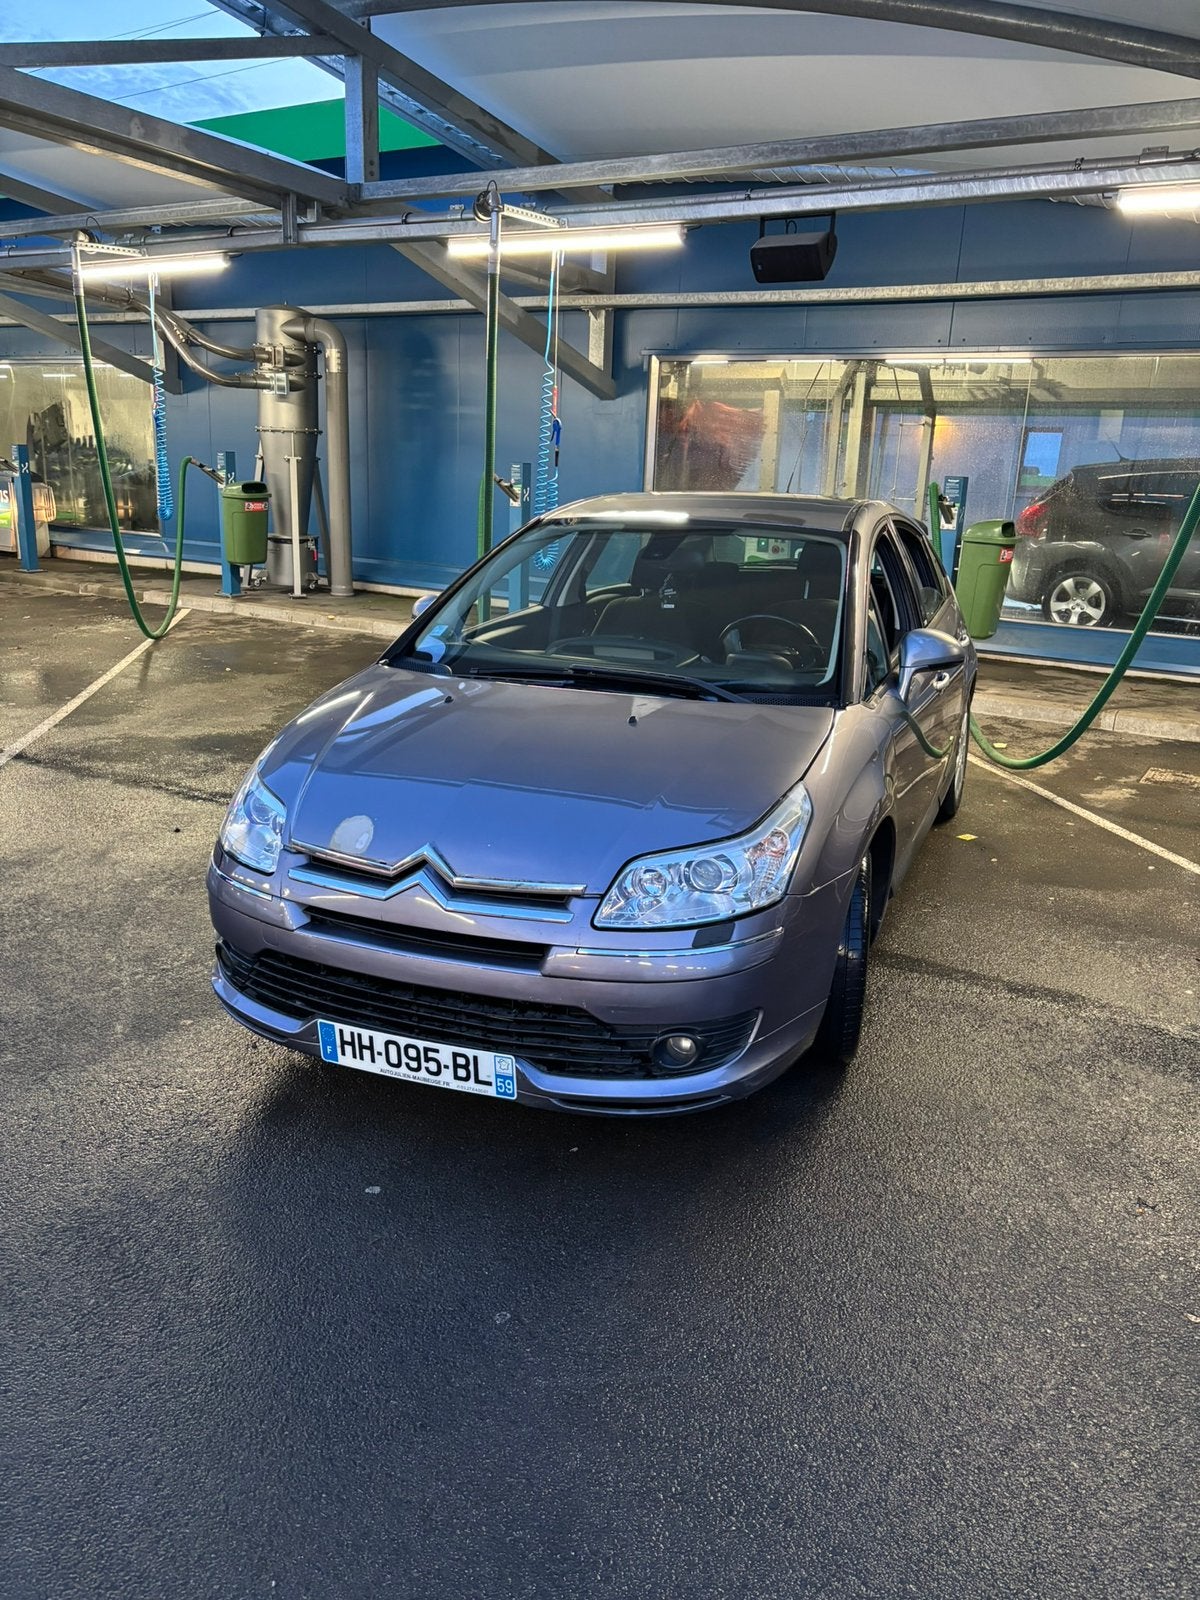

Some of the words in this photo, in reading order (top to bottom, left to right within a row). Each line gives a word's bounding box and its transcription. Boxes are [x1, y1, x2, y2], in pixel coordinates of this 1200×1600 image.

[327, 1046, 332, 1055] F
[338, 1028, 493, 1087] HH-095-BL
[497, 1078, 513, 1094] 59
